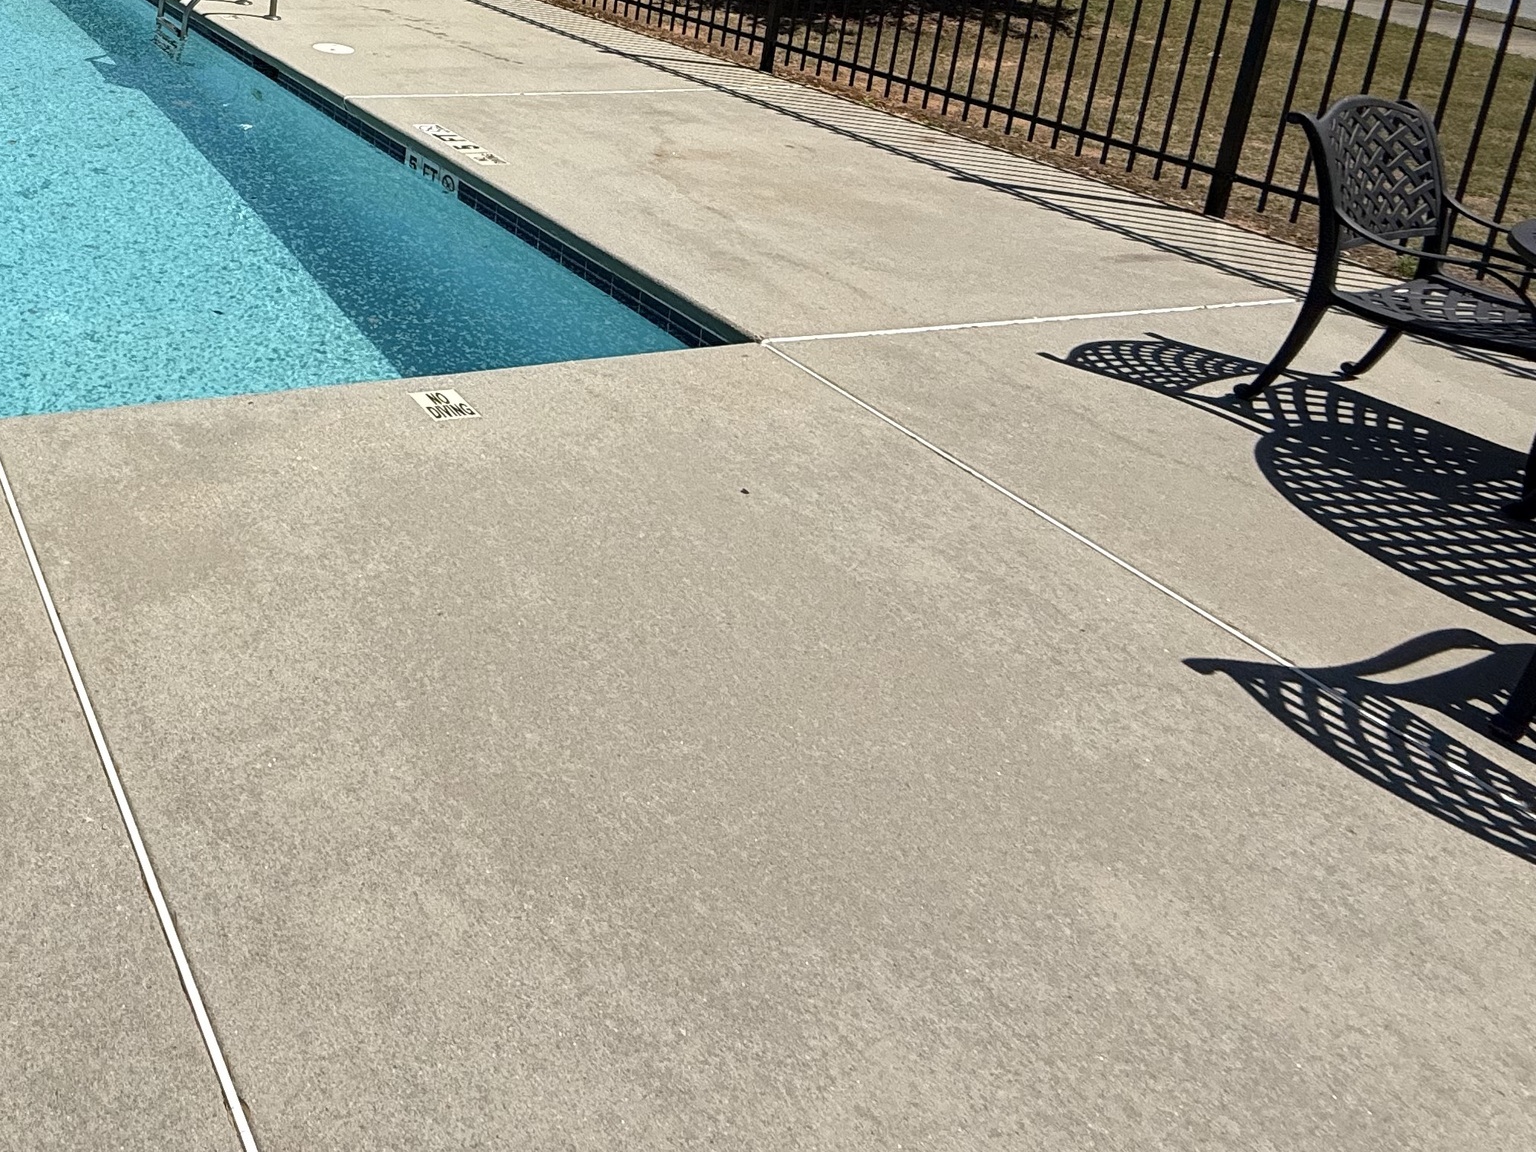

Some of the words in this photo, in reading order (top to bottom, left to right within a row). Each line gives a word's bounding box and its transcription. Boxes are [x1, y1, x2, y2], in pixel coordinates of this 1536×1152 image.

[409, 155, 418, 170] 5
[423, 163, 438, 182] FT
[425, 392, 450, 405] NO
[425, 403, 476, 419] DIVING
